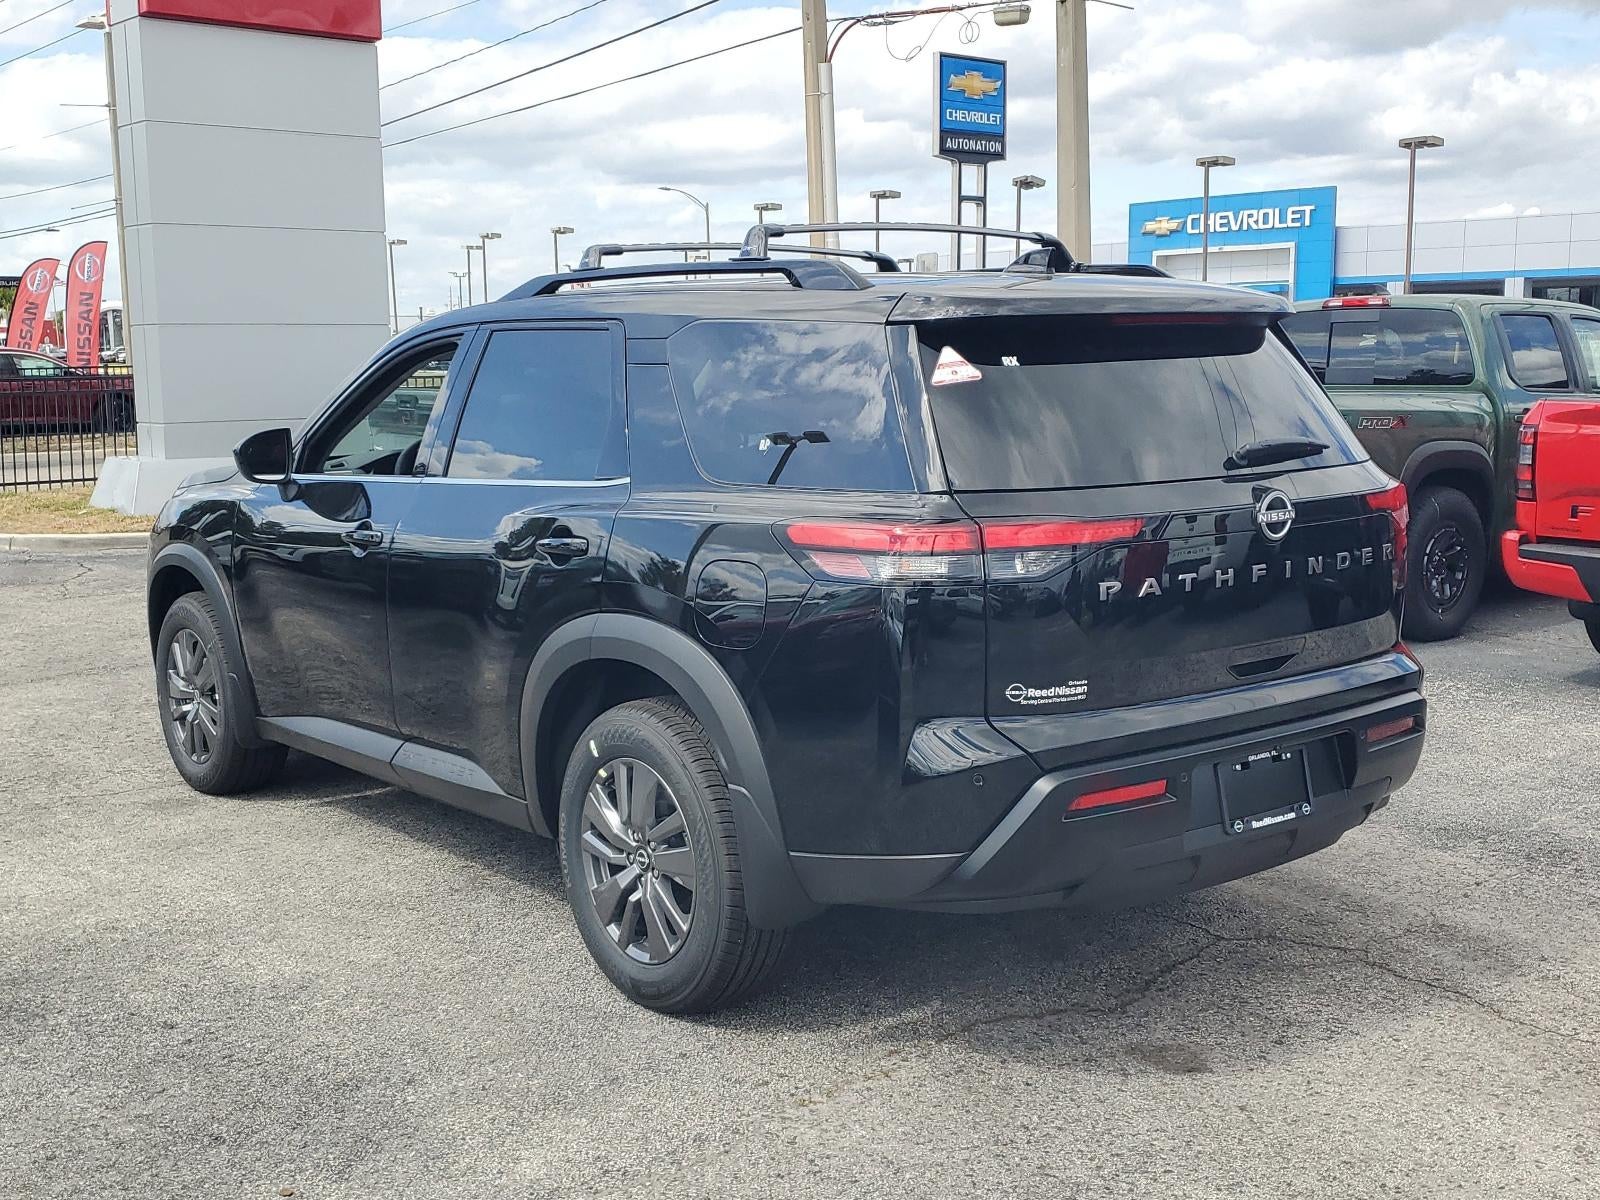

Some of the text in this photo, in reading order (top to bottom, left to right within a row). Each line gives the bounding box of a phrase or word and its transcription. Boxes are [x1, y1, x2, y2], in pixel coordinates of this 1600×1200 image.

[946, 109, 1001, 125] CHEVROLET
[946, 137, 1002, 152] AUTONATION
[1186, 205, 1315, 234] CHEVROLET
[1259, 510, 1295, 522] NISSAN
[1099, 543, 1394, 601] PATHFINDER
[1251, 811, 1296, 829] ReedNissan.com
